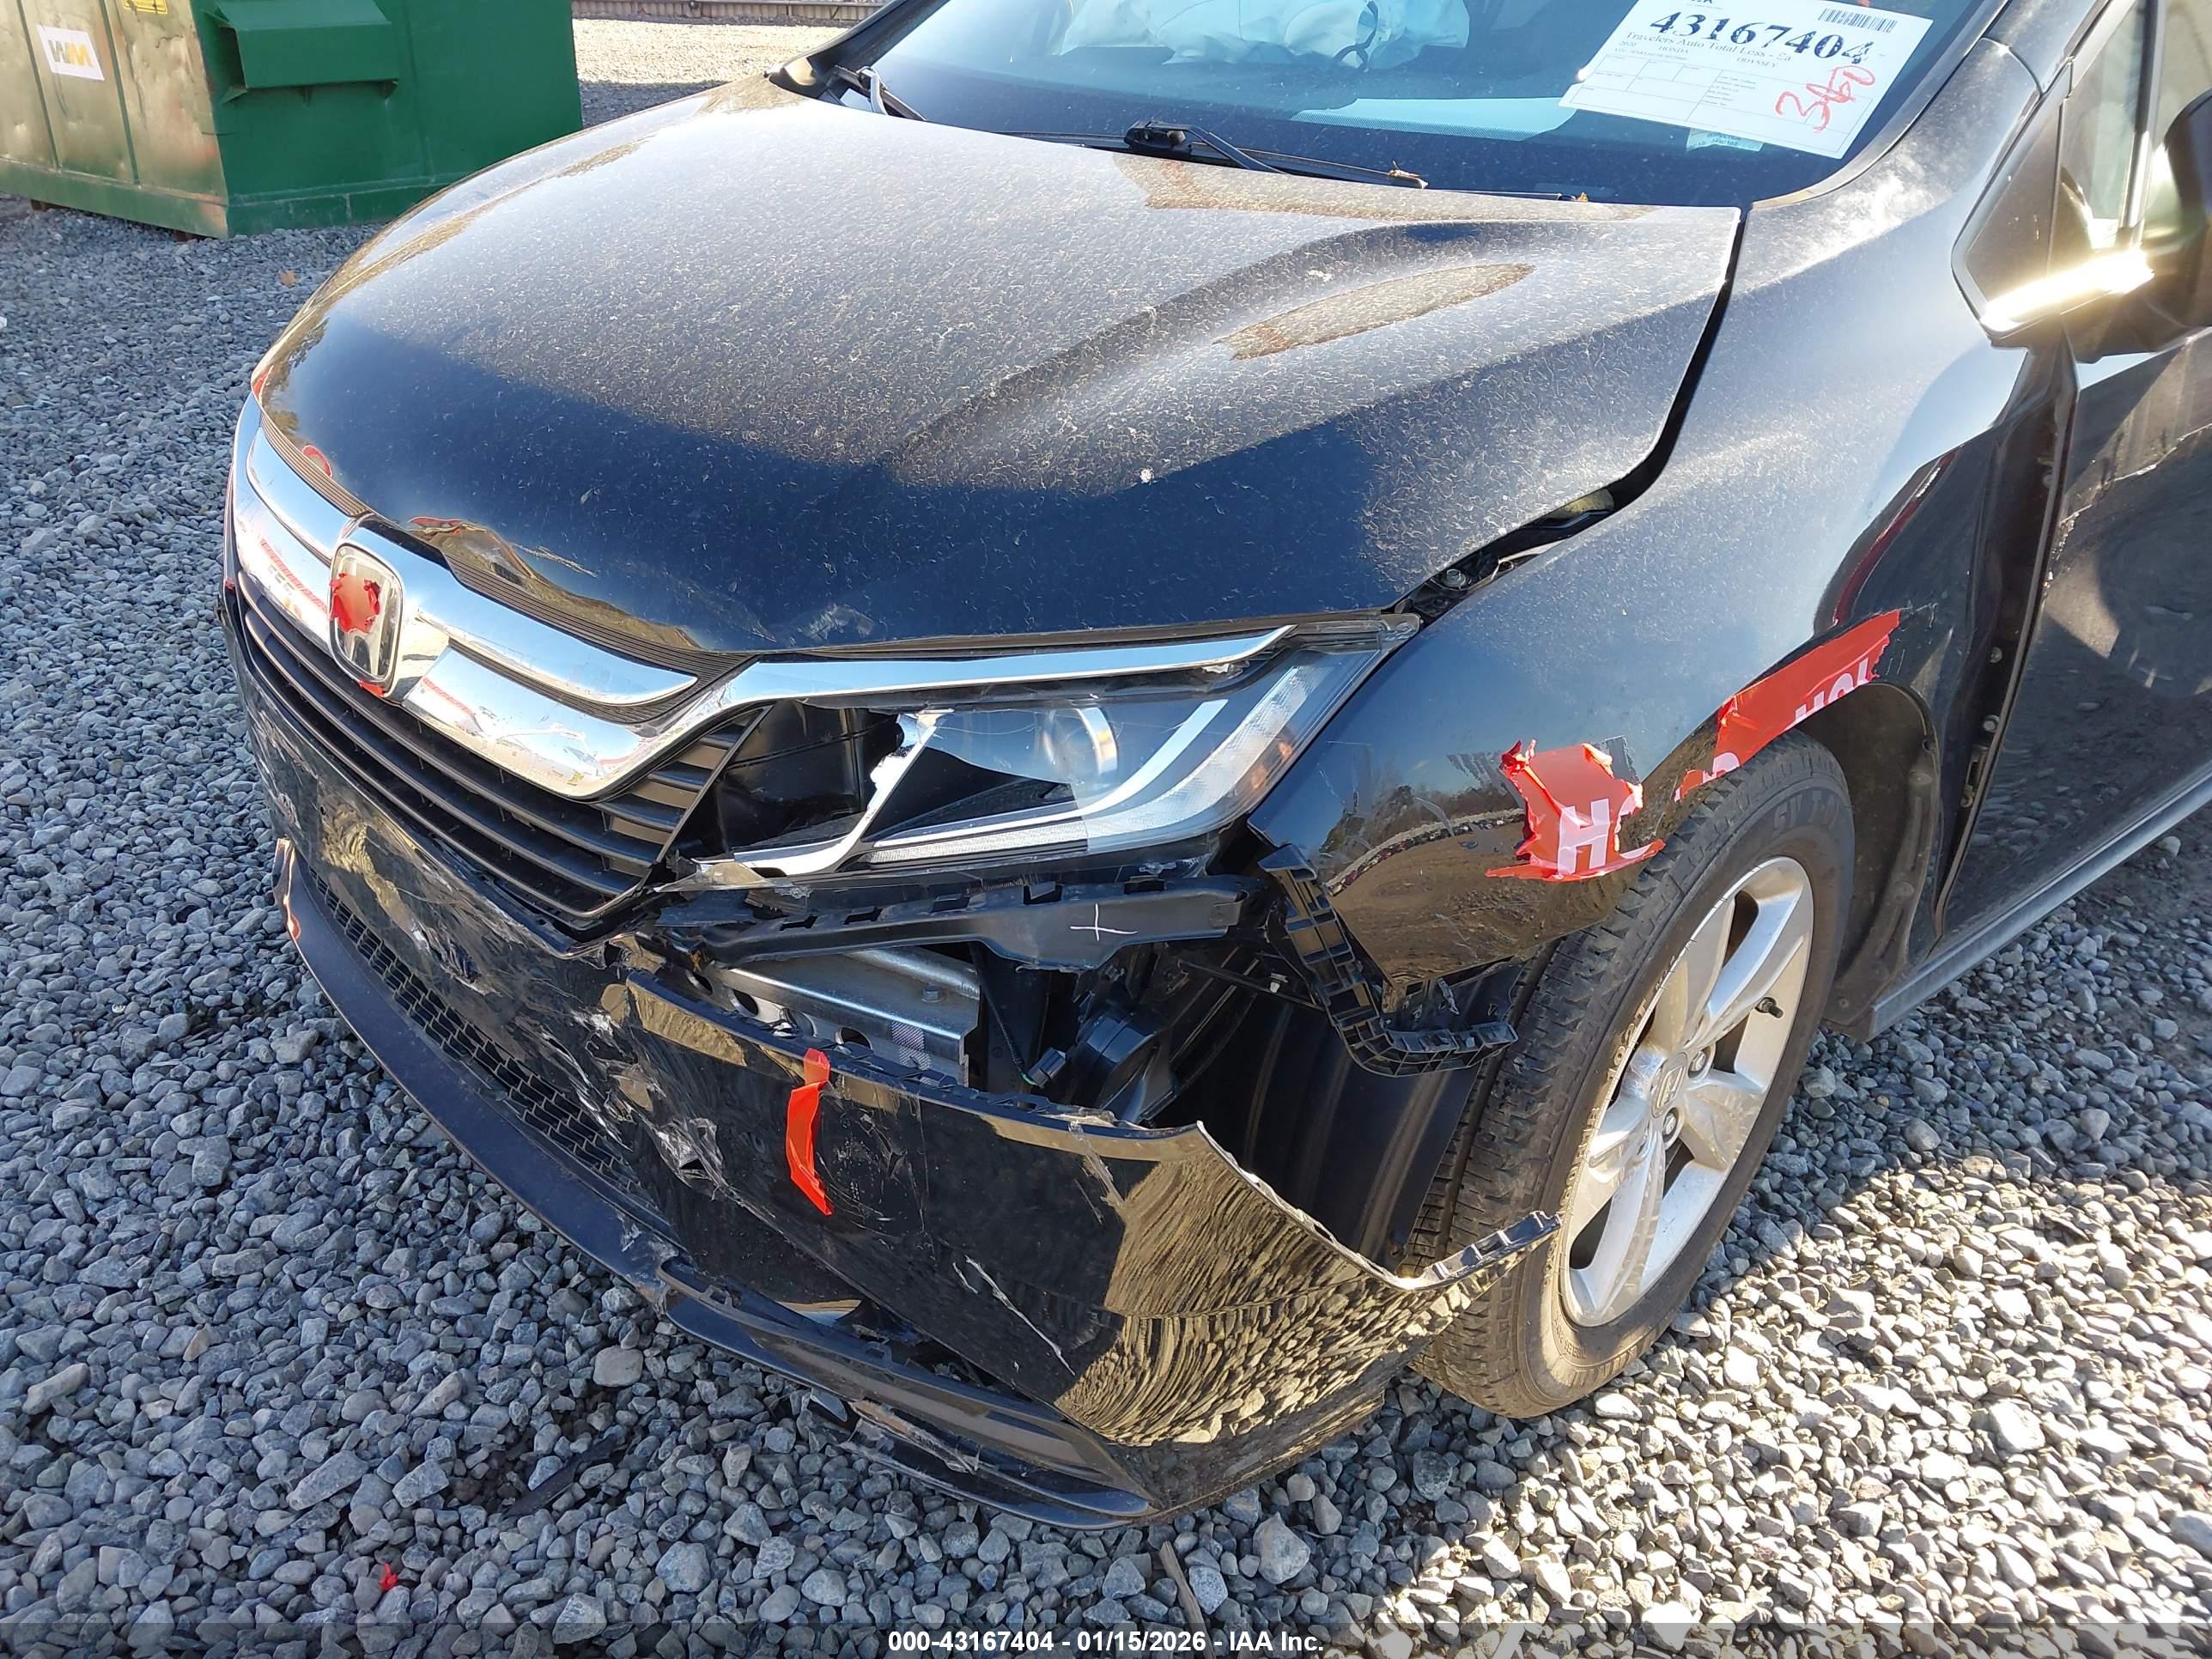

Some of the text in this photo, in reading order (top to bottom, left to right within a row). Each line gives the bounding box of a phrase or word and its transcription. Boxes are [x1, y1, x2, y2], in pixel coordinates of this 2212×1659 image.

[1626, 31, 1674, 45] Travelers
[1678, 38, 1705, 48] Auto
[1709, 42, 1738, 53] Total
[1650, 11, 1875, 64] 43167404
[47, 40, 94, 68] WM
